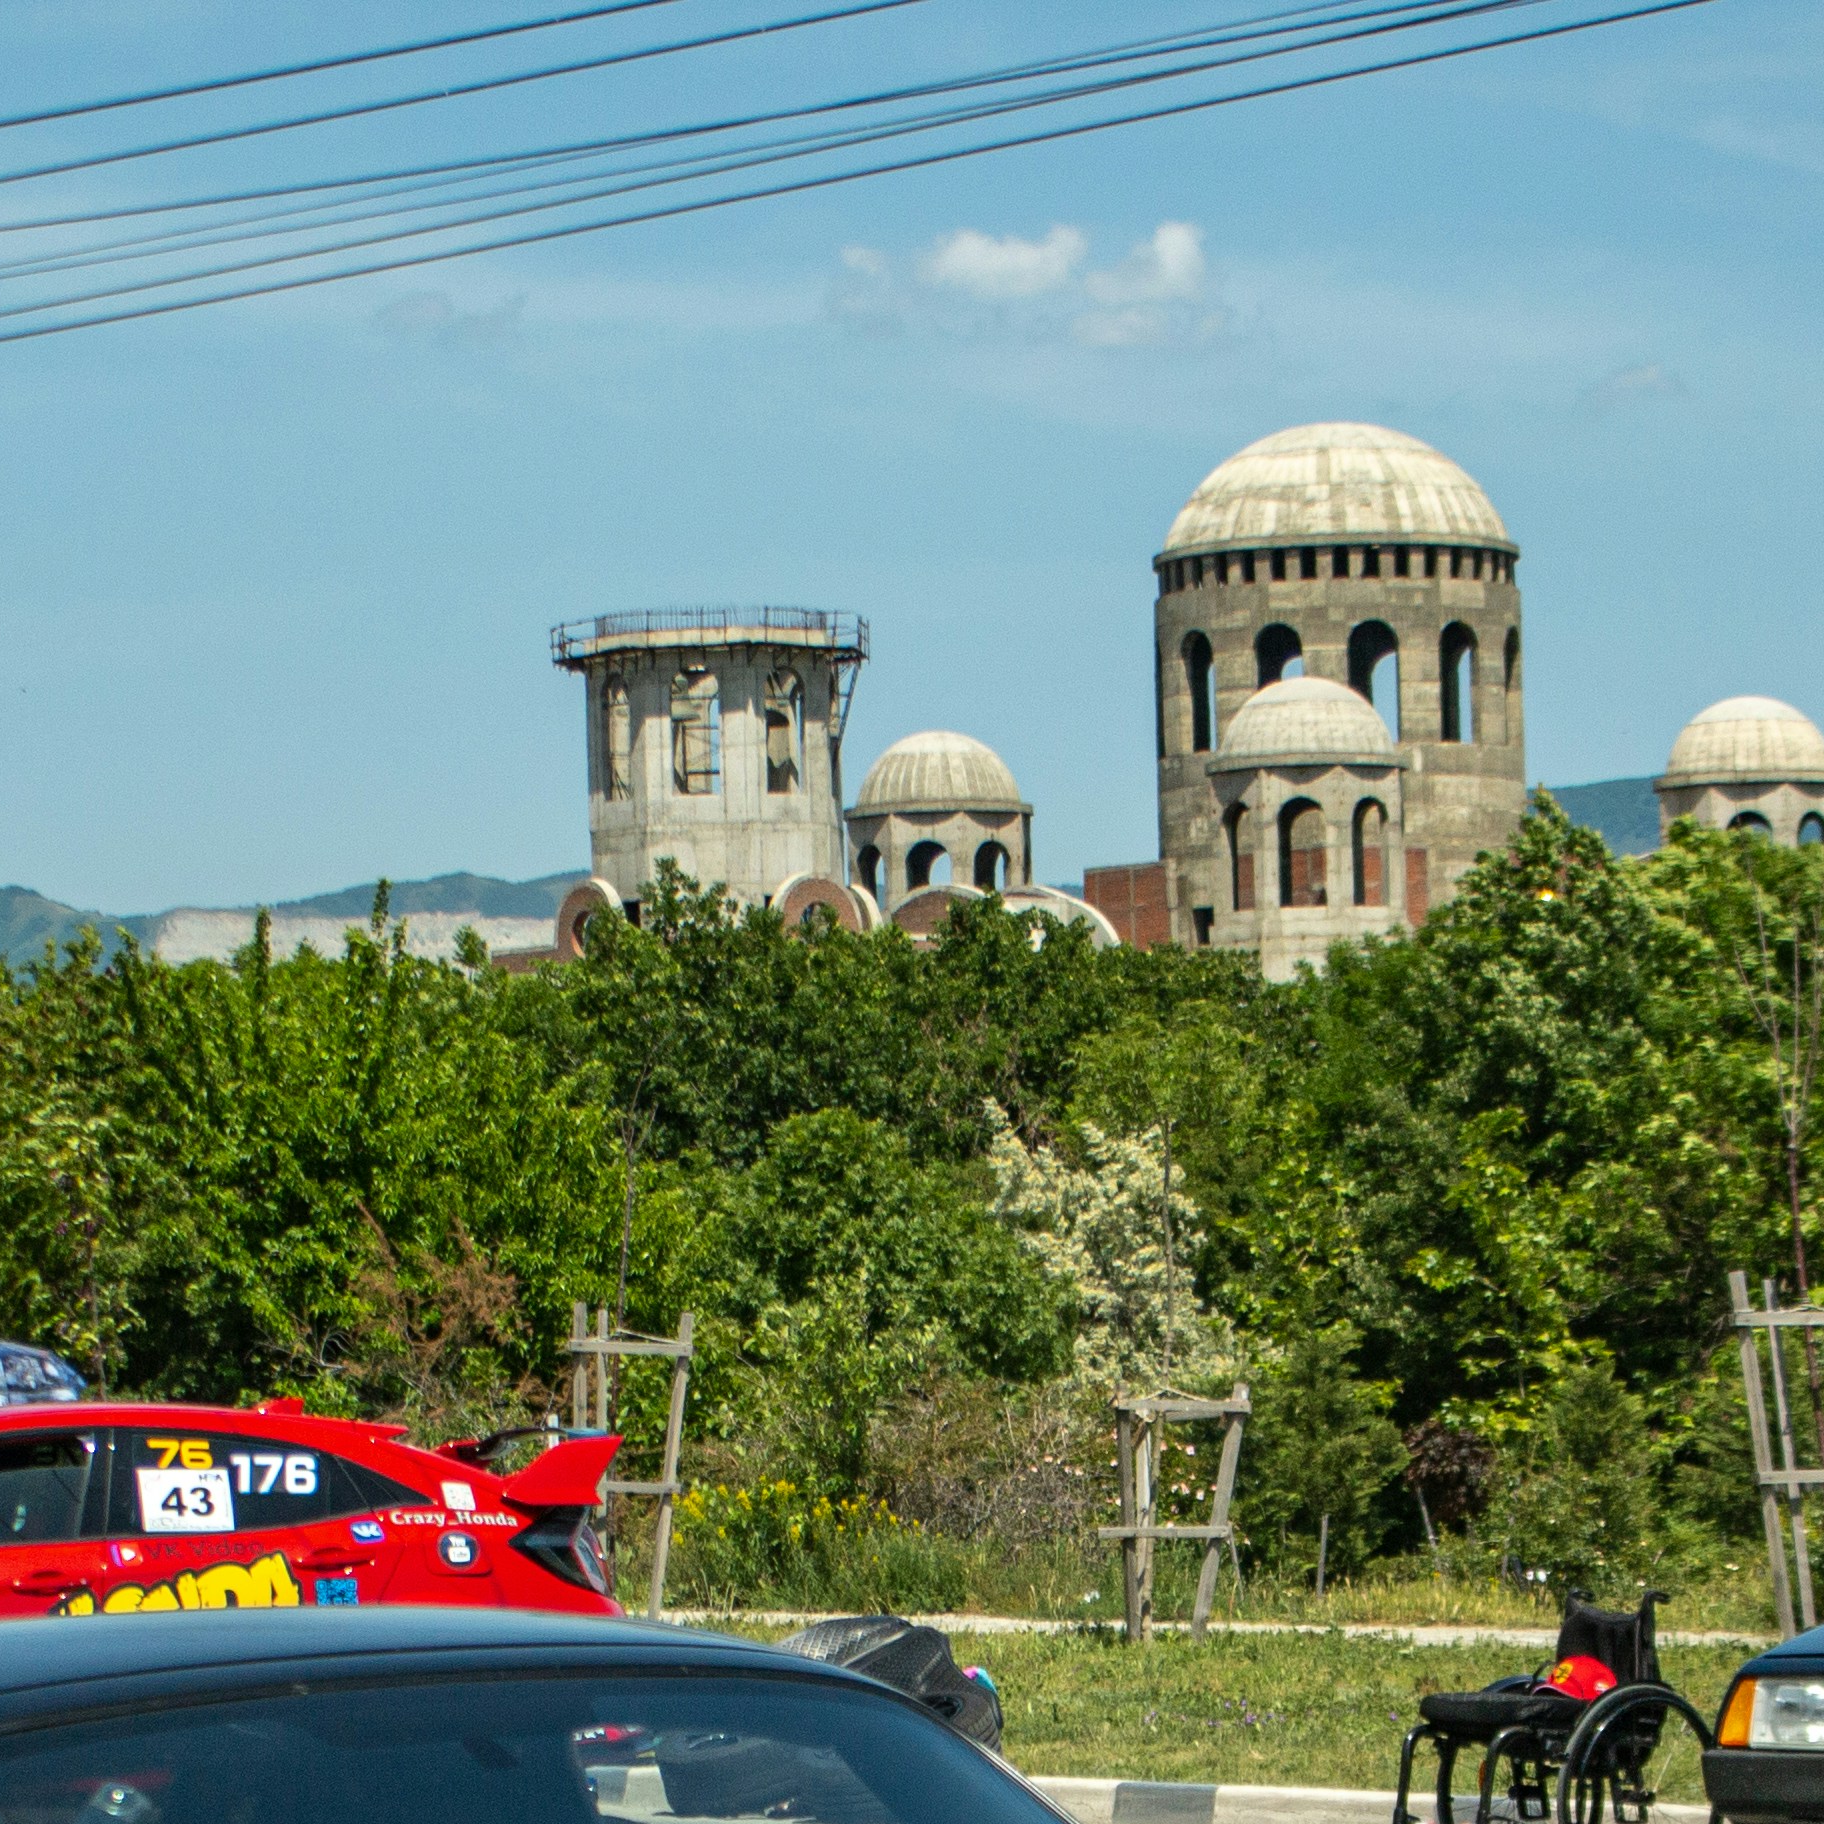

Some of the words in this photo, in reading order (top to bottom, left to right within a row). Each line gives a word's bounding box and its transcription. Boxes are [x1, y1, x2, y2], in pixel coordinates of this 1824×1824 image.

[146, 1438, 214, 1469] 76
[230, 1454, 320, 1494] 176
[161, 1486, 215, 1516] 43
[389, 1510, 518, 1527] Crazy_Honda
[188, 1539, 264, 1556] Video
